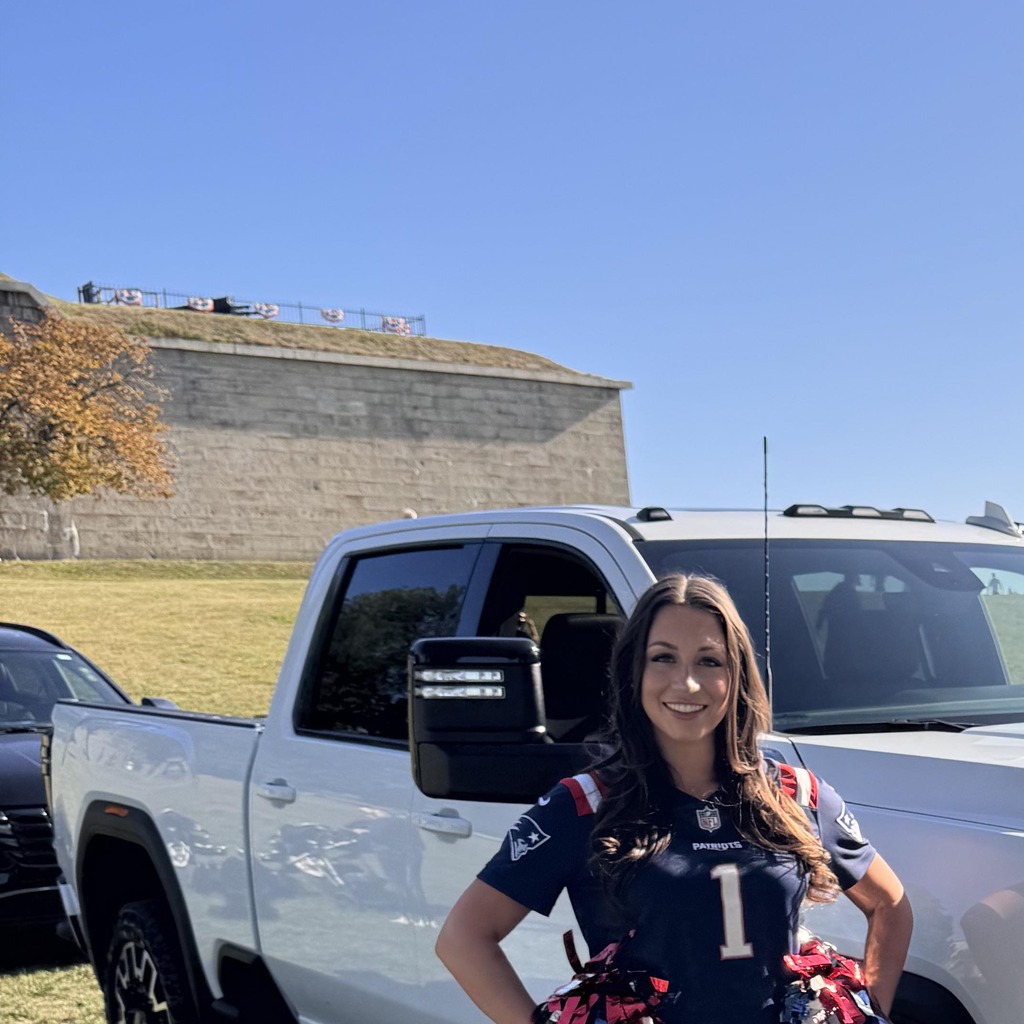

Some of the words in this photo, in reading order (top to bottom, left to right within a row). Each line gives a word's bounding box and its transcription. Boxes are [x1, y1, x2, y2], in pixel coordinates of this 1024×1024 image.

[701, 817, 718, 827] NFL
[692, 841, 742, 851] PATRIOTS
[709, 863, 754, 960] 1
